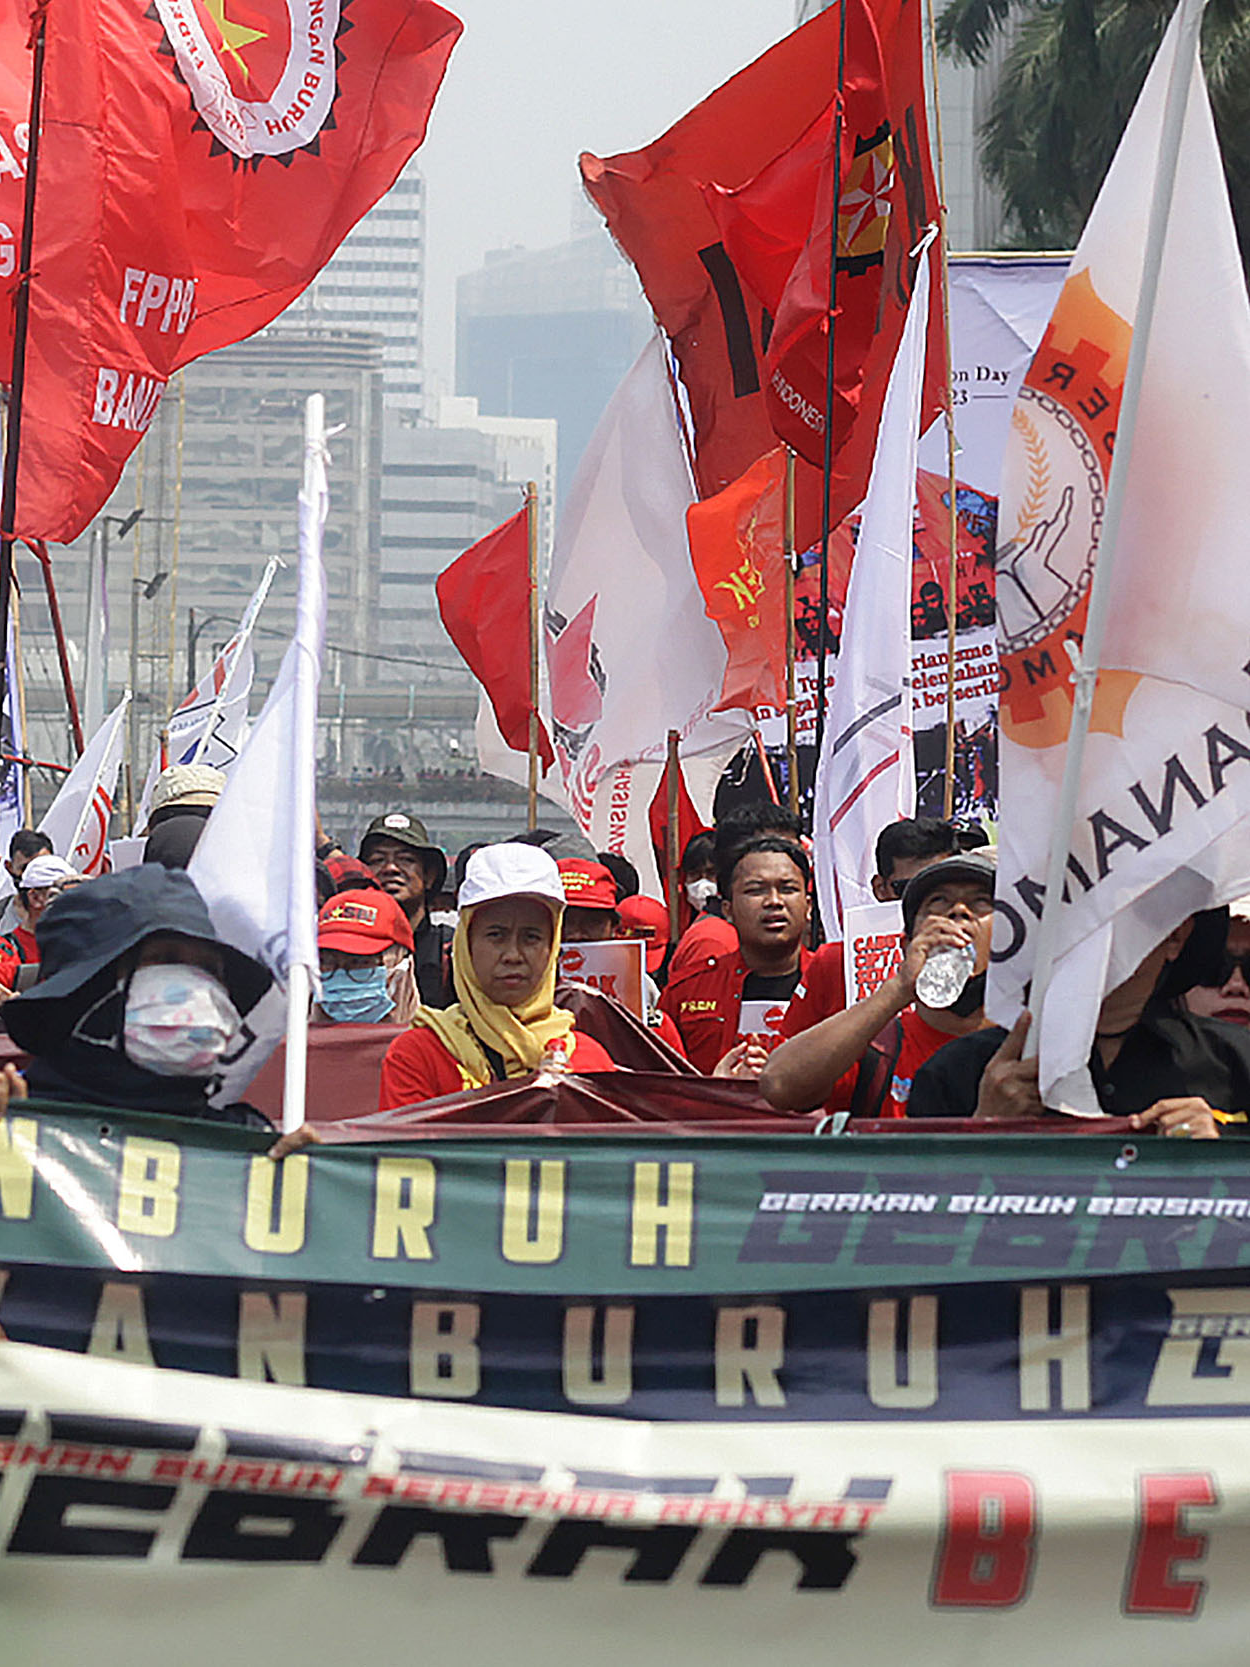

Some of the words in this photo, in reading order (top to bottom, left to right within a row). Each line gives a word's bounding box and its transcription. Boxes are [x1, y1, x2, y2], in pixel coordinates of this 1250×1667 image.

[265, 71, 321, 136] BURUH
[976, 365, 1011, 386] Day
[758, 1191, 938, 1213] GERAKAN
[947, 1193, 1078, 1215] BURUH
[1086, 1196, 1250, 1218] BERSAM
[154, 1458, 343, 1495] BURUH
[363, 1474, 637, 1519] BERSAMA
[658, 1498, 886, 1531] RAKYAT
